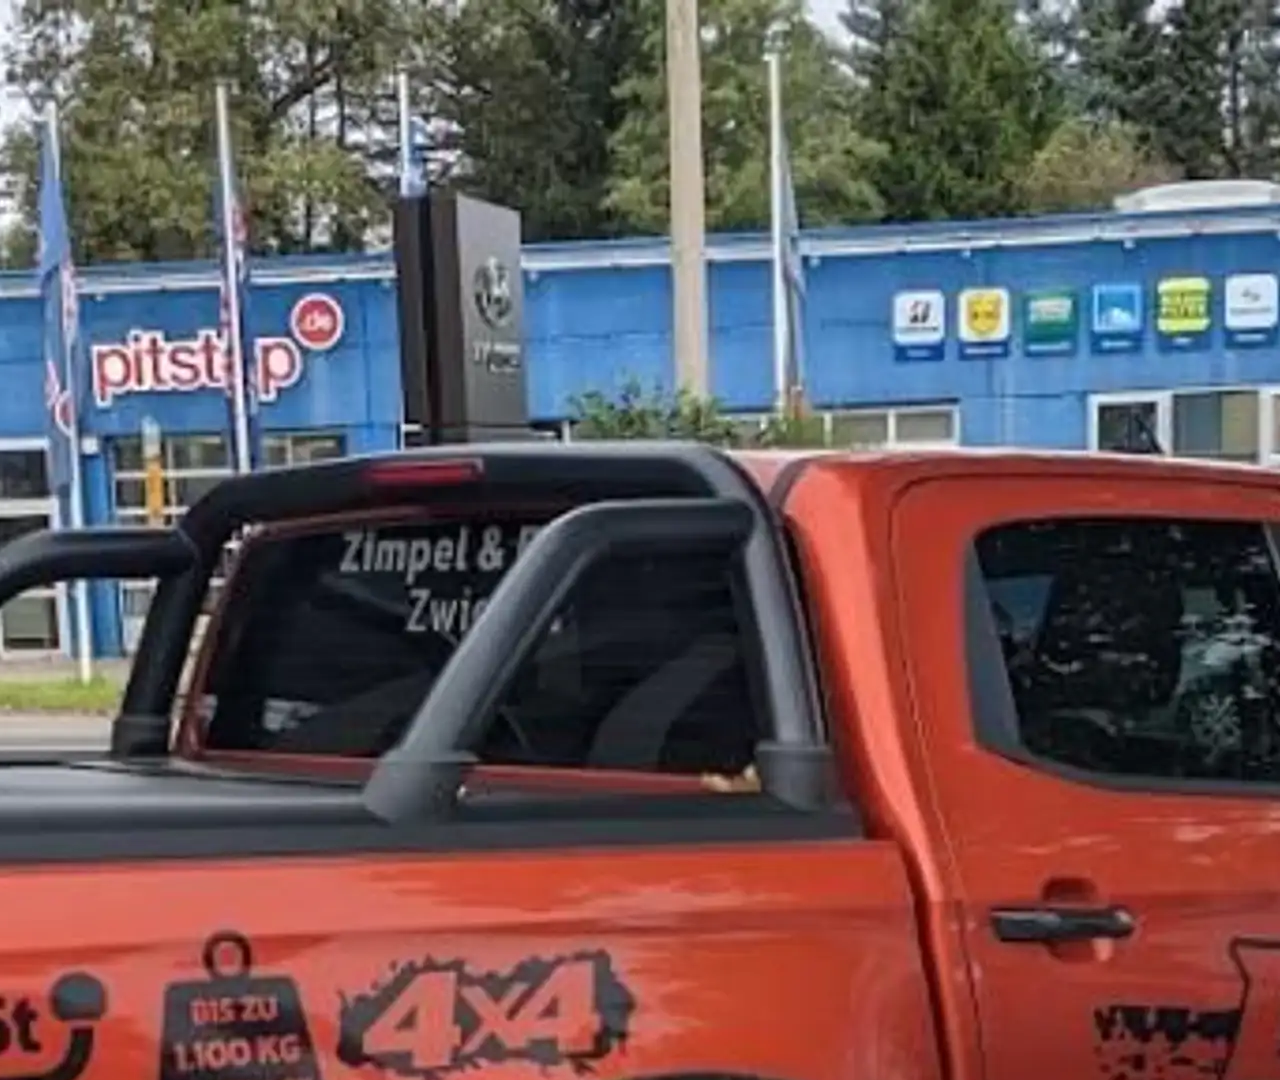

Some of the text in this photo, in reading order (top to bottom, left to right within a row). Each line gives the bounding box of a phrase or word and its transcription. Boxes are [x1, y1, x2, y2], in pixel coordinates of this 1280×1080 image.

[93, 329, 301, 404] pitstp
[340, 525, 469, 585] Zimpel
[477, 524, 505, 571] &
[190, 995, 279, 1025] BIS ZU
[257, 1033, 301, 1064] KG
